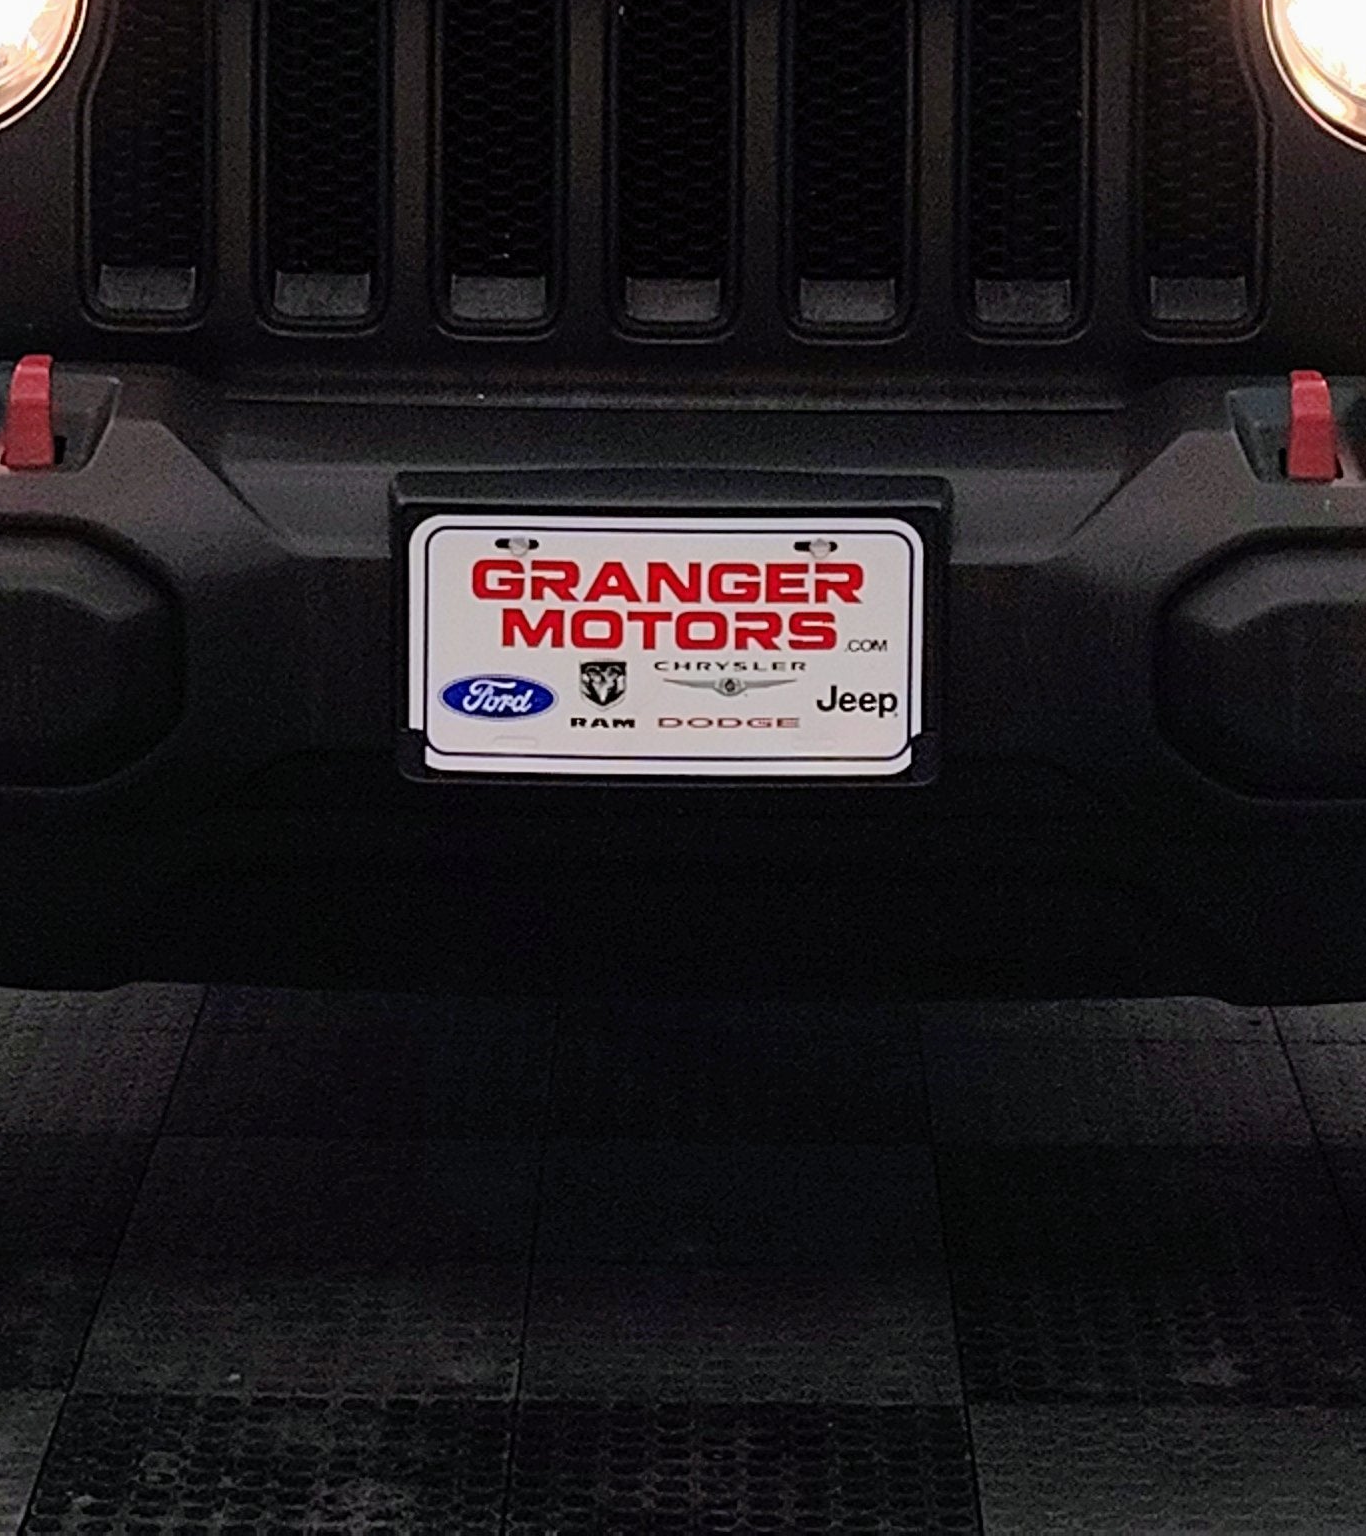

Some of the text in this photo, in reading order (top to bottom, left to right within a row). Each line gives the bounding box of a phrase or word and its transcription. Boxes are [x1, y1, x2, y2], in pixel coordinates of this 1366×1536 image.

[471, 558, 864, 604] GRANGER
[501, 608, 888, 653] MOTORS .COM
[654, 660, 807, 672] CHRYSLER
[462, 678, 534, 713] Ford
[816, 685, 898, 718] Jeep
[570, 717, 636, 729] RAM
[658, 717, 801, 729] DODGE
